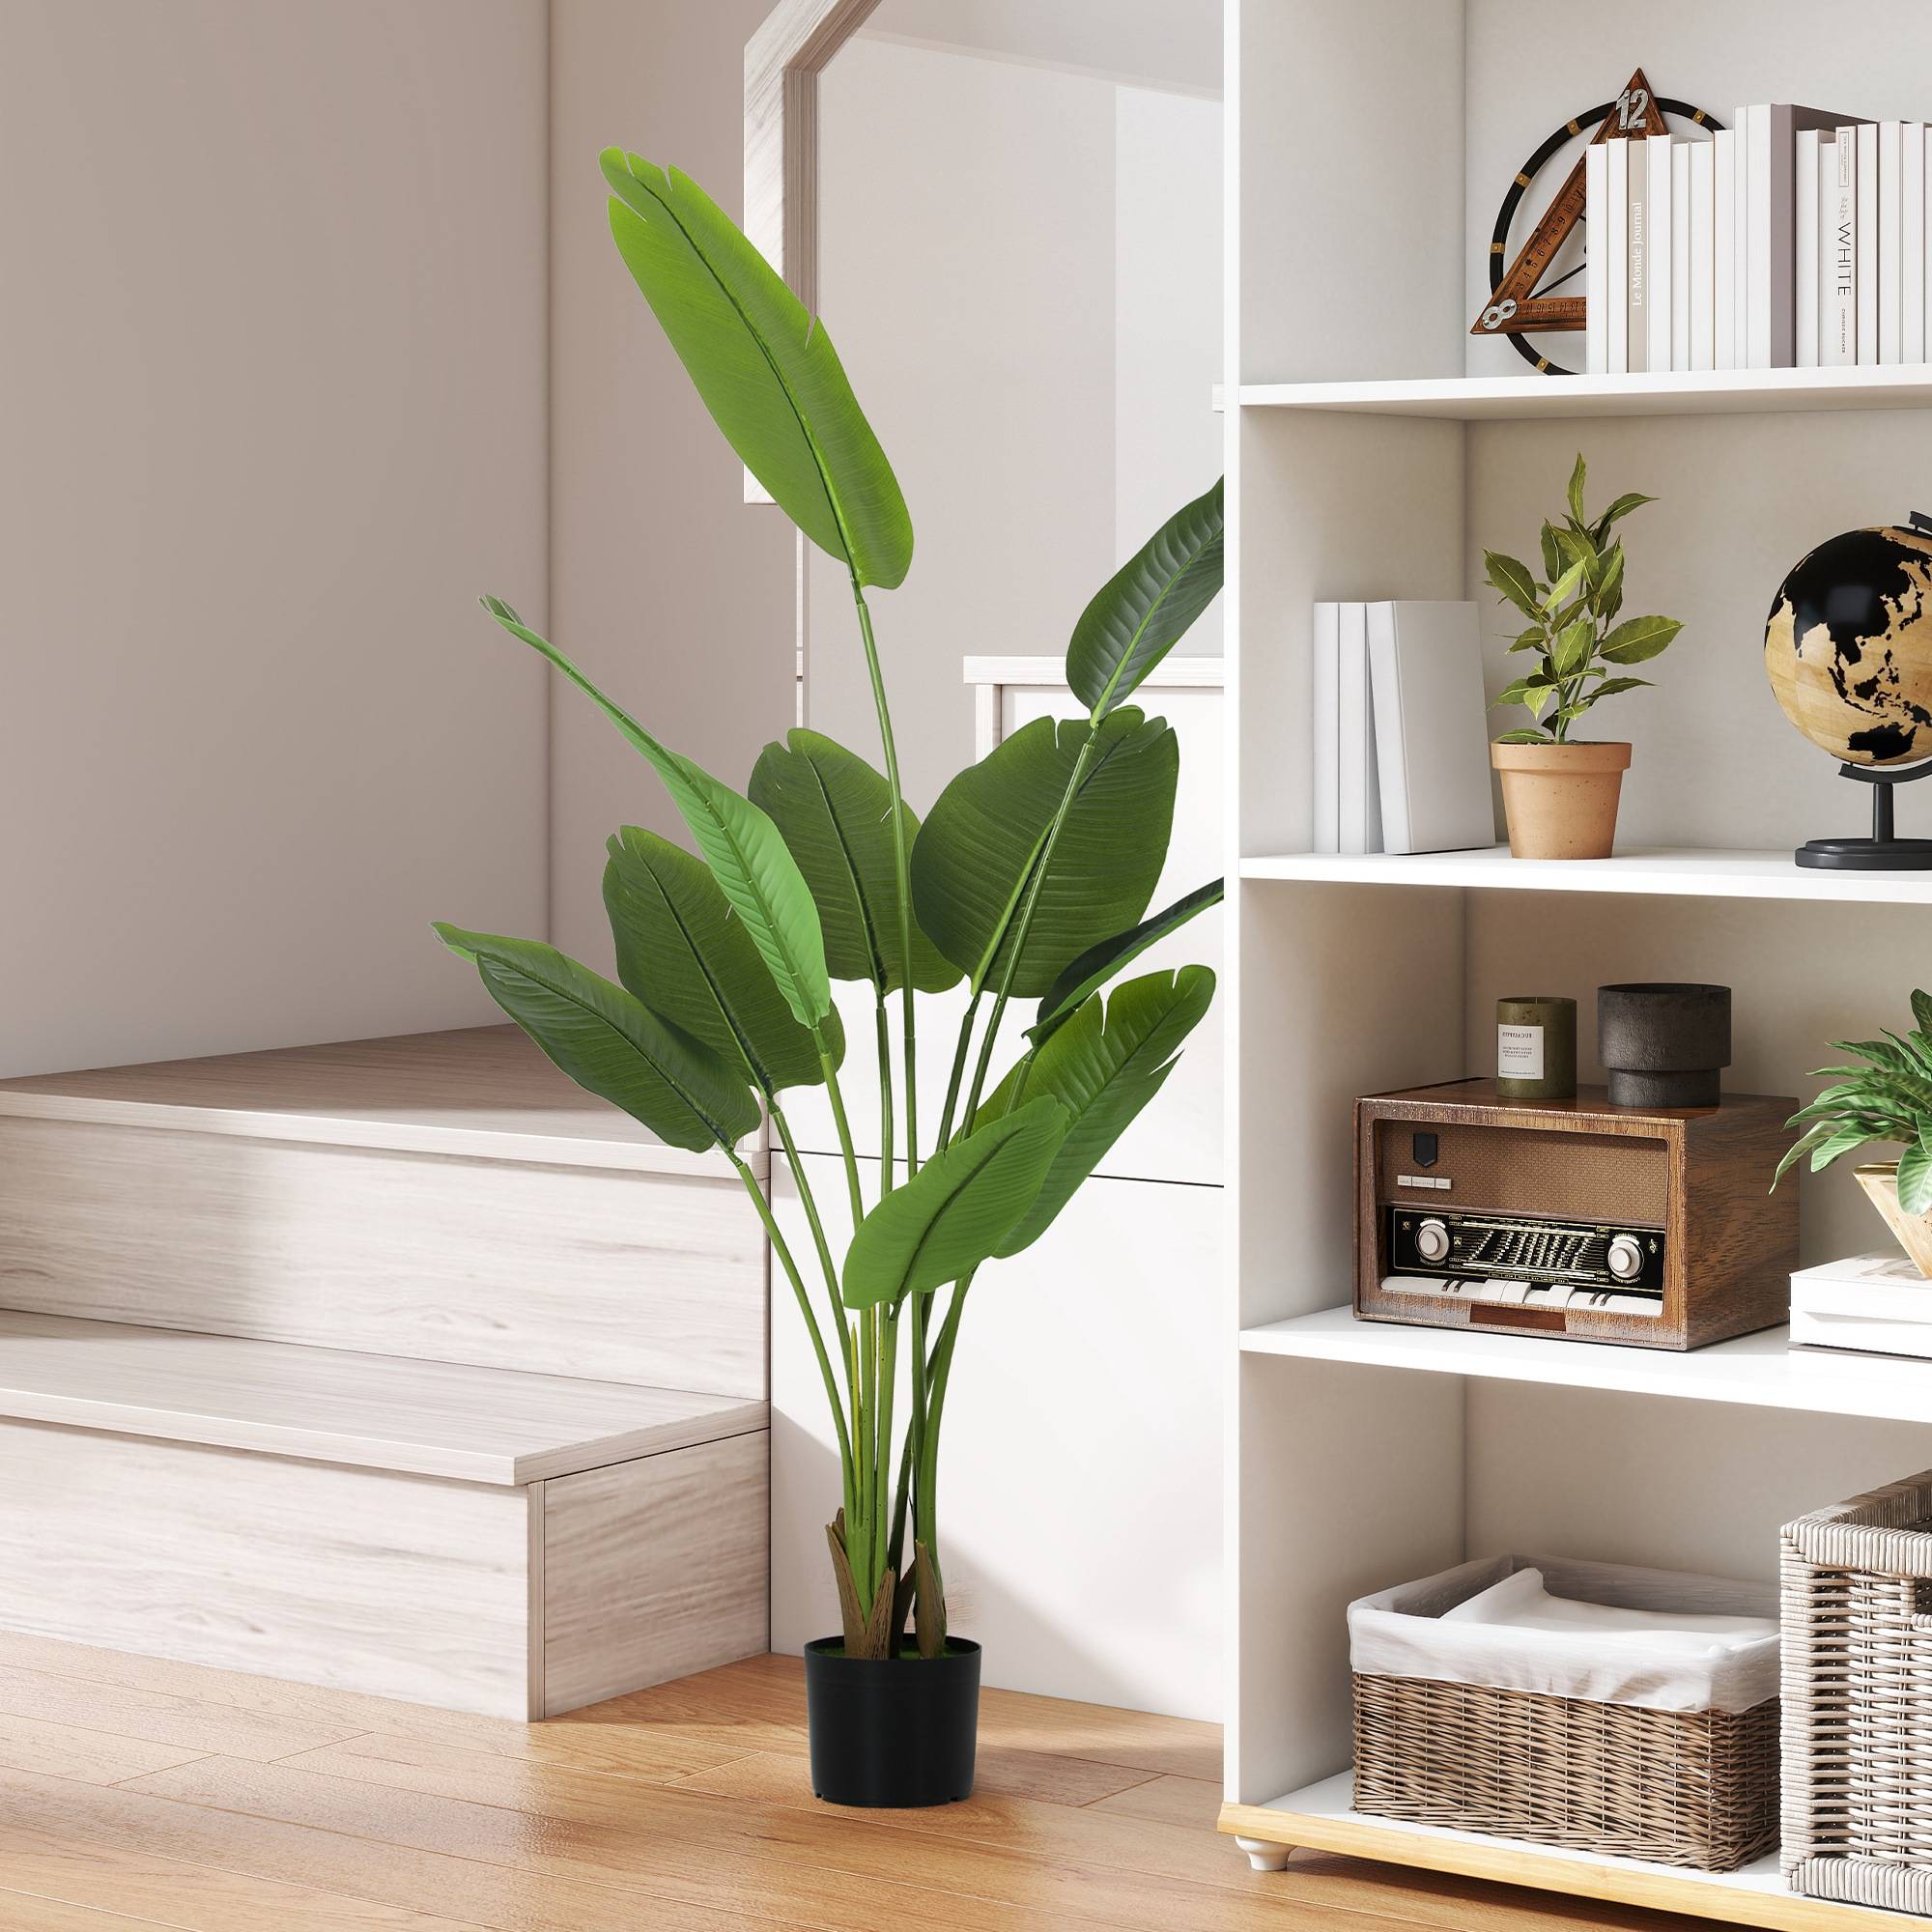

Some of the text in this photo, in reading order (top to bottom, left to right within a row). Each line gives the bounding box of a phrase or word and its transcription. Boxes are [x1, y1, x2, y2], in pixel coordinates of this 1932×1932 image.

[1616, 88, 1649, 130] 12
[1632, 201, 1643, 306] Le Monde Journal
[1837, 221, 1852, 297] WHITE
[1482, 298, 1518, 330] 8
